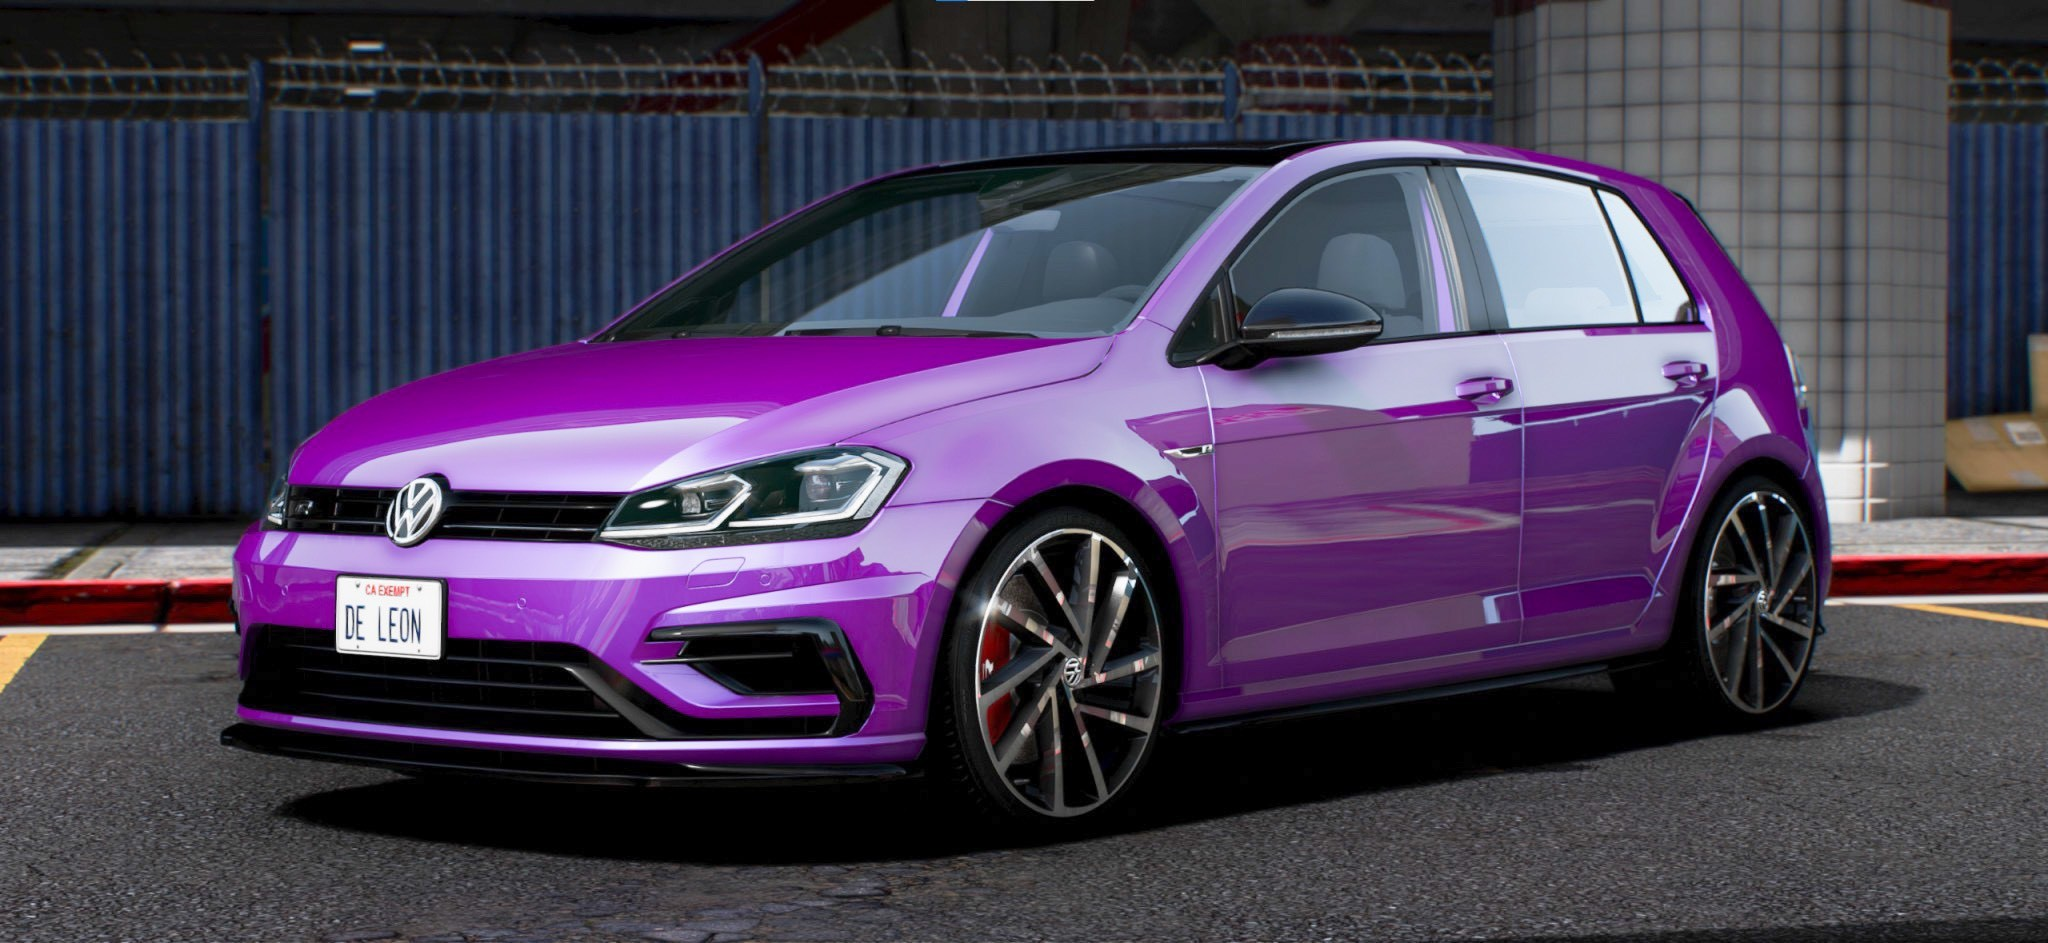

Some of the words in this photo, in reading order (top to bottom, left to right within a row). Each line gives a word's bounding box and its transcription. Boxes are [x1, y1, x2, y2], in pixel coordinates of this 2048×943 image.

[387, 477, 443, 545] VW
[365, 584, 376, 596] CA
[378, 585, 410, 597] EXEMPT
[345, 605, 365, 640] DE
[378, 605, 421, 643] LEON
